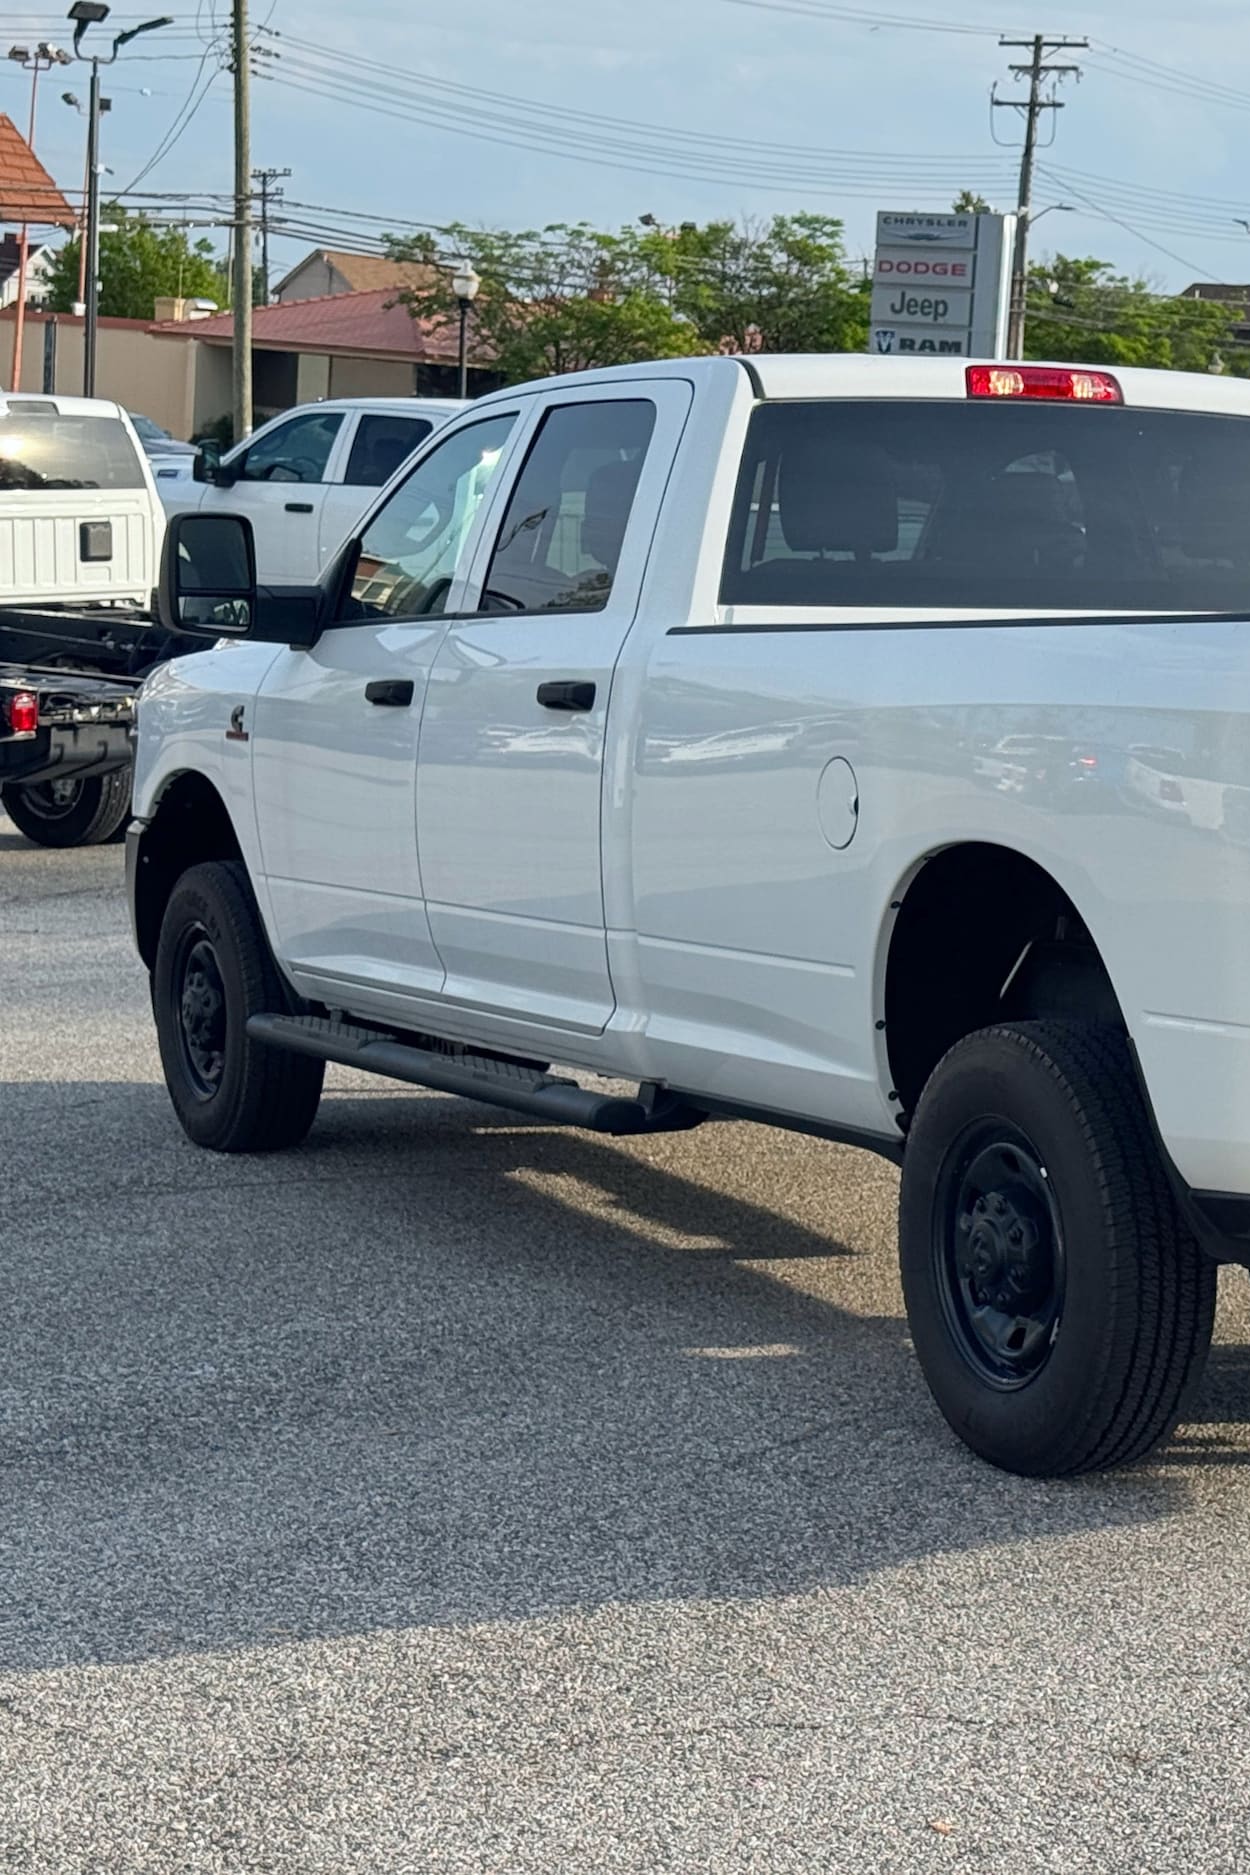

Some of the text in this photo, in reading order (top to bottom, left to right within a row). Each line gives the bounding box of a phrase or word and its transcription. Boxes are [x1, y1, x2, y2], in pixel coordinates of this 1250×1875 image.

[882, 216, 968, 228] CHRYSLER
[878, 260, 967, 276] DODGE
[890, 291, 949, 321] Jeep
[899, 338, 962, 353] RAM
